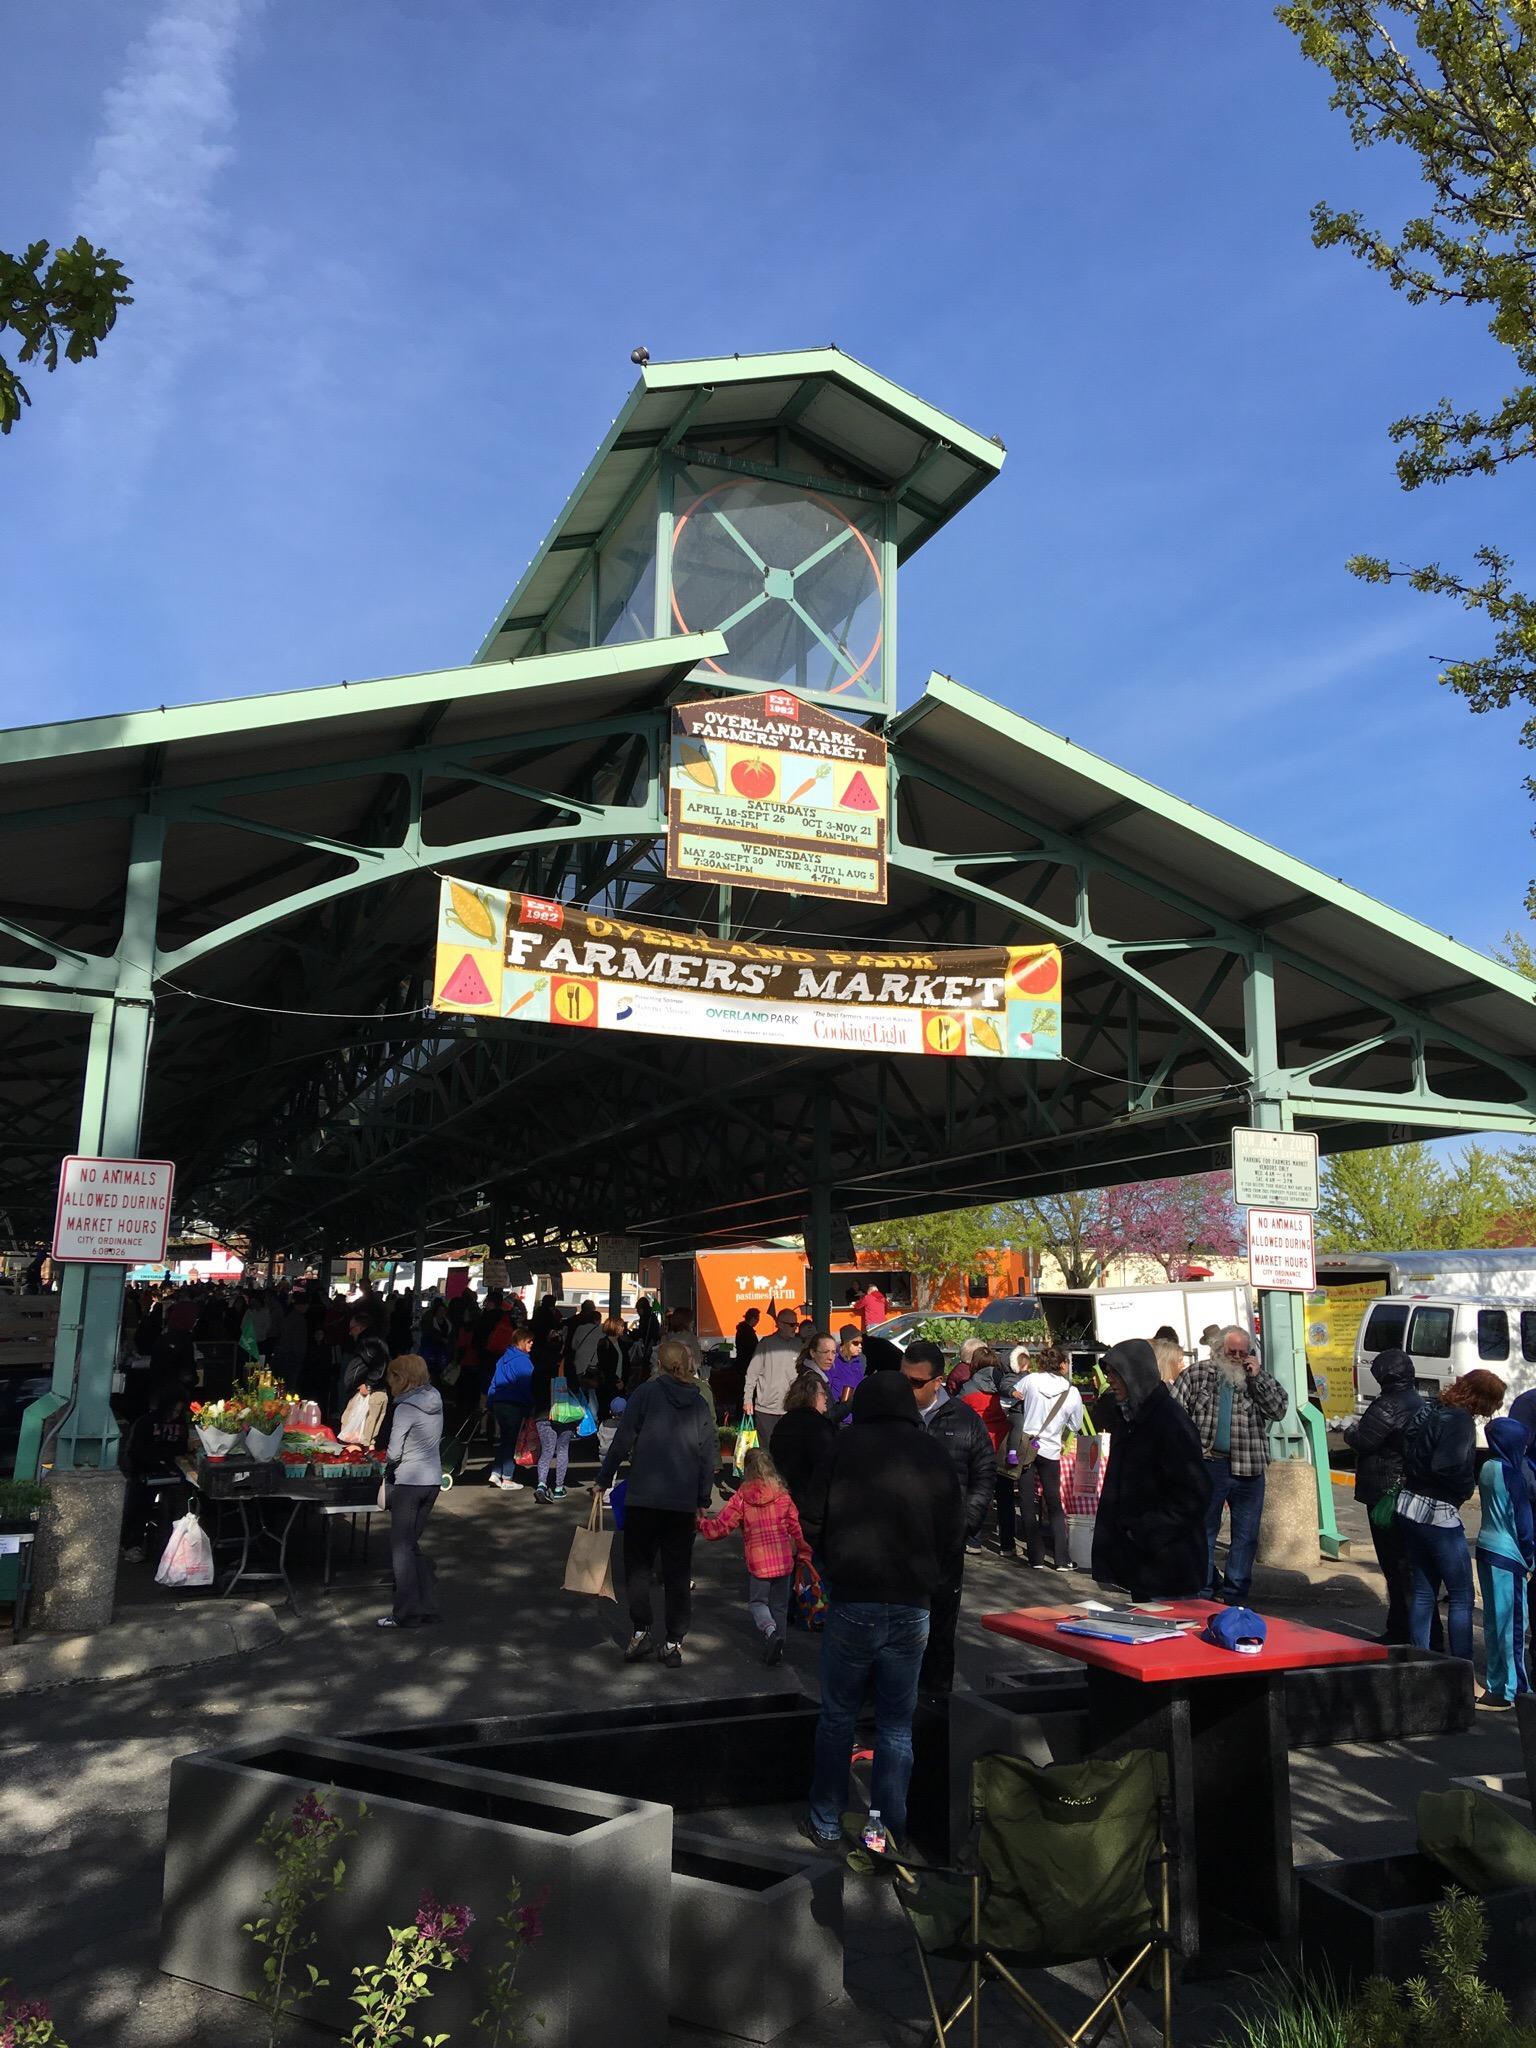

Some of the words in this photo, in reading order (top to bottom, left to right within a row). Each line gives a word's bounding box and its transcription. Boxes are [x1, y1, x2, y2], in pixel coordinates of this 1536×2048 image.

[769, 695, 795, 706] EST.
[769, 704, 794, 715] 1982
[704, 711, 803, 738] OVERLAND
[808, 727, 856, 747] PARK
[692, 722, 784, 747] FARMERS'
[789, 737, 867, 760] MARKET
[687, 803, 722, 816] APRIL
[725, 808, 770, 822] 18-SEPT
[773, 814, 785, 823] 26
[747, 800, 817, 818] SATURDAYS
[802, 818, 823, 828] OCT
[826, 821, 857, 833] 3-NOV
[860, 826, 872, 836] 21
[683, 847, 706, 858] MAY
[708, 850, 750, 863] 20-SEPT
[752, 857, 764, 865] 30
[741, 843, 822, 864] WEDNESDAYS
[775, 859, 801, 870] JUNE
[813, 864, 835, 875] JULY
[846, 869, 867, 880] AUG
[869, 872, 875, 881] 5
[811, 873, 841, 885] 4-7PM
[525, 909, 560, 923] 1982
[586, 917, 817, 963] OVERLAND
[826, 953, 938, 971] PARK
[506, 929, 783, 994] FARMERS'
[793, 967, 1005, 1008] MARKET
[79, 1168, 96, 1183] NO
[102, 1169, 157, 1186] ANIMALS
[63, 1192, 118, 1208] ALLOWED
[121, 1194, 165, 1210] DURING
[66, 1216, 113, 1232] MARKET
[117, 1219, 157, 1234] HOURS
[1258, 1217, 1268, 1229] NO
[1271, 1217, 1303, 1231] ANIMALS
[77, 1235, 95, 1245] CITY
[97, 1236, 143, 1246] ORDINANCE
[1251, 1235, 1283, 1248] ALLOWED
[1284, 1237, 1311, 1250] DURING
[1254, 1254, 1282, 1267] MARKET
[1284, 1256, 1309, 1269] HOURS
[1274, 1269, 1302, 1278] ORDINANCE
[735, 1290, 769, 1303] pastimes
[769, 1286, 796, 1300] farm
